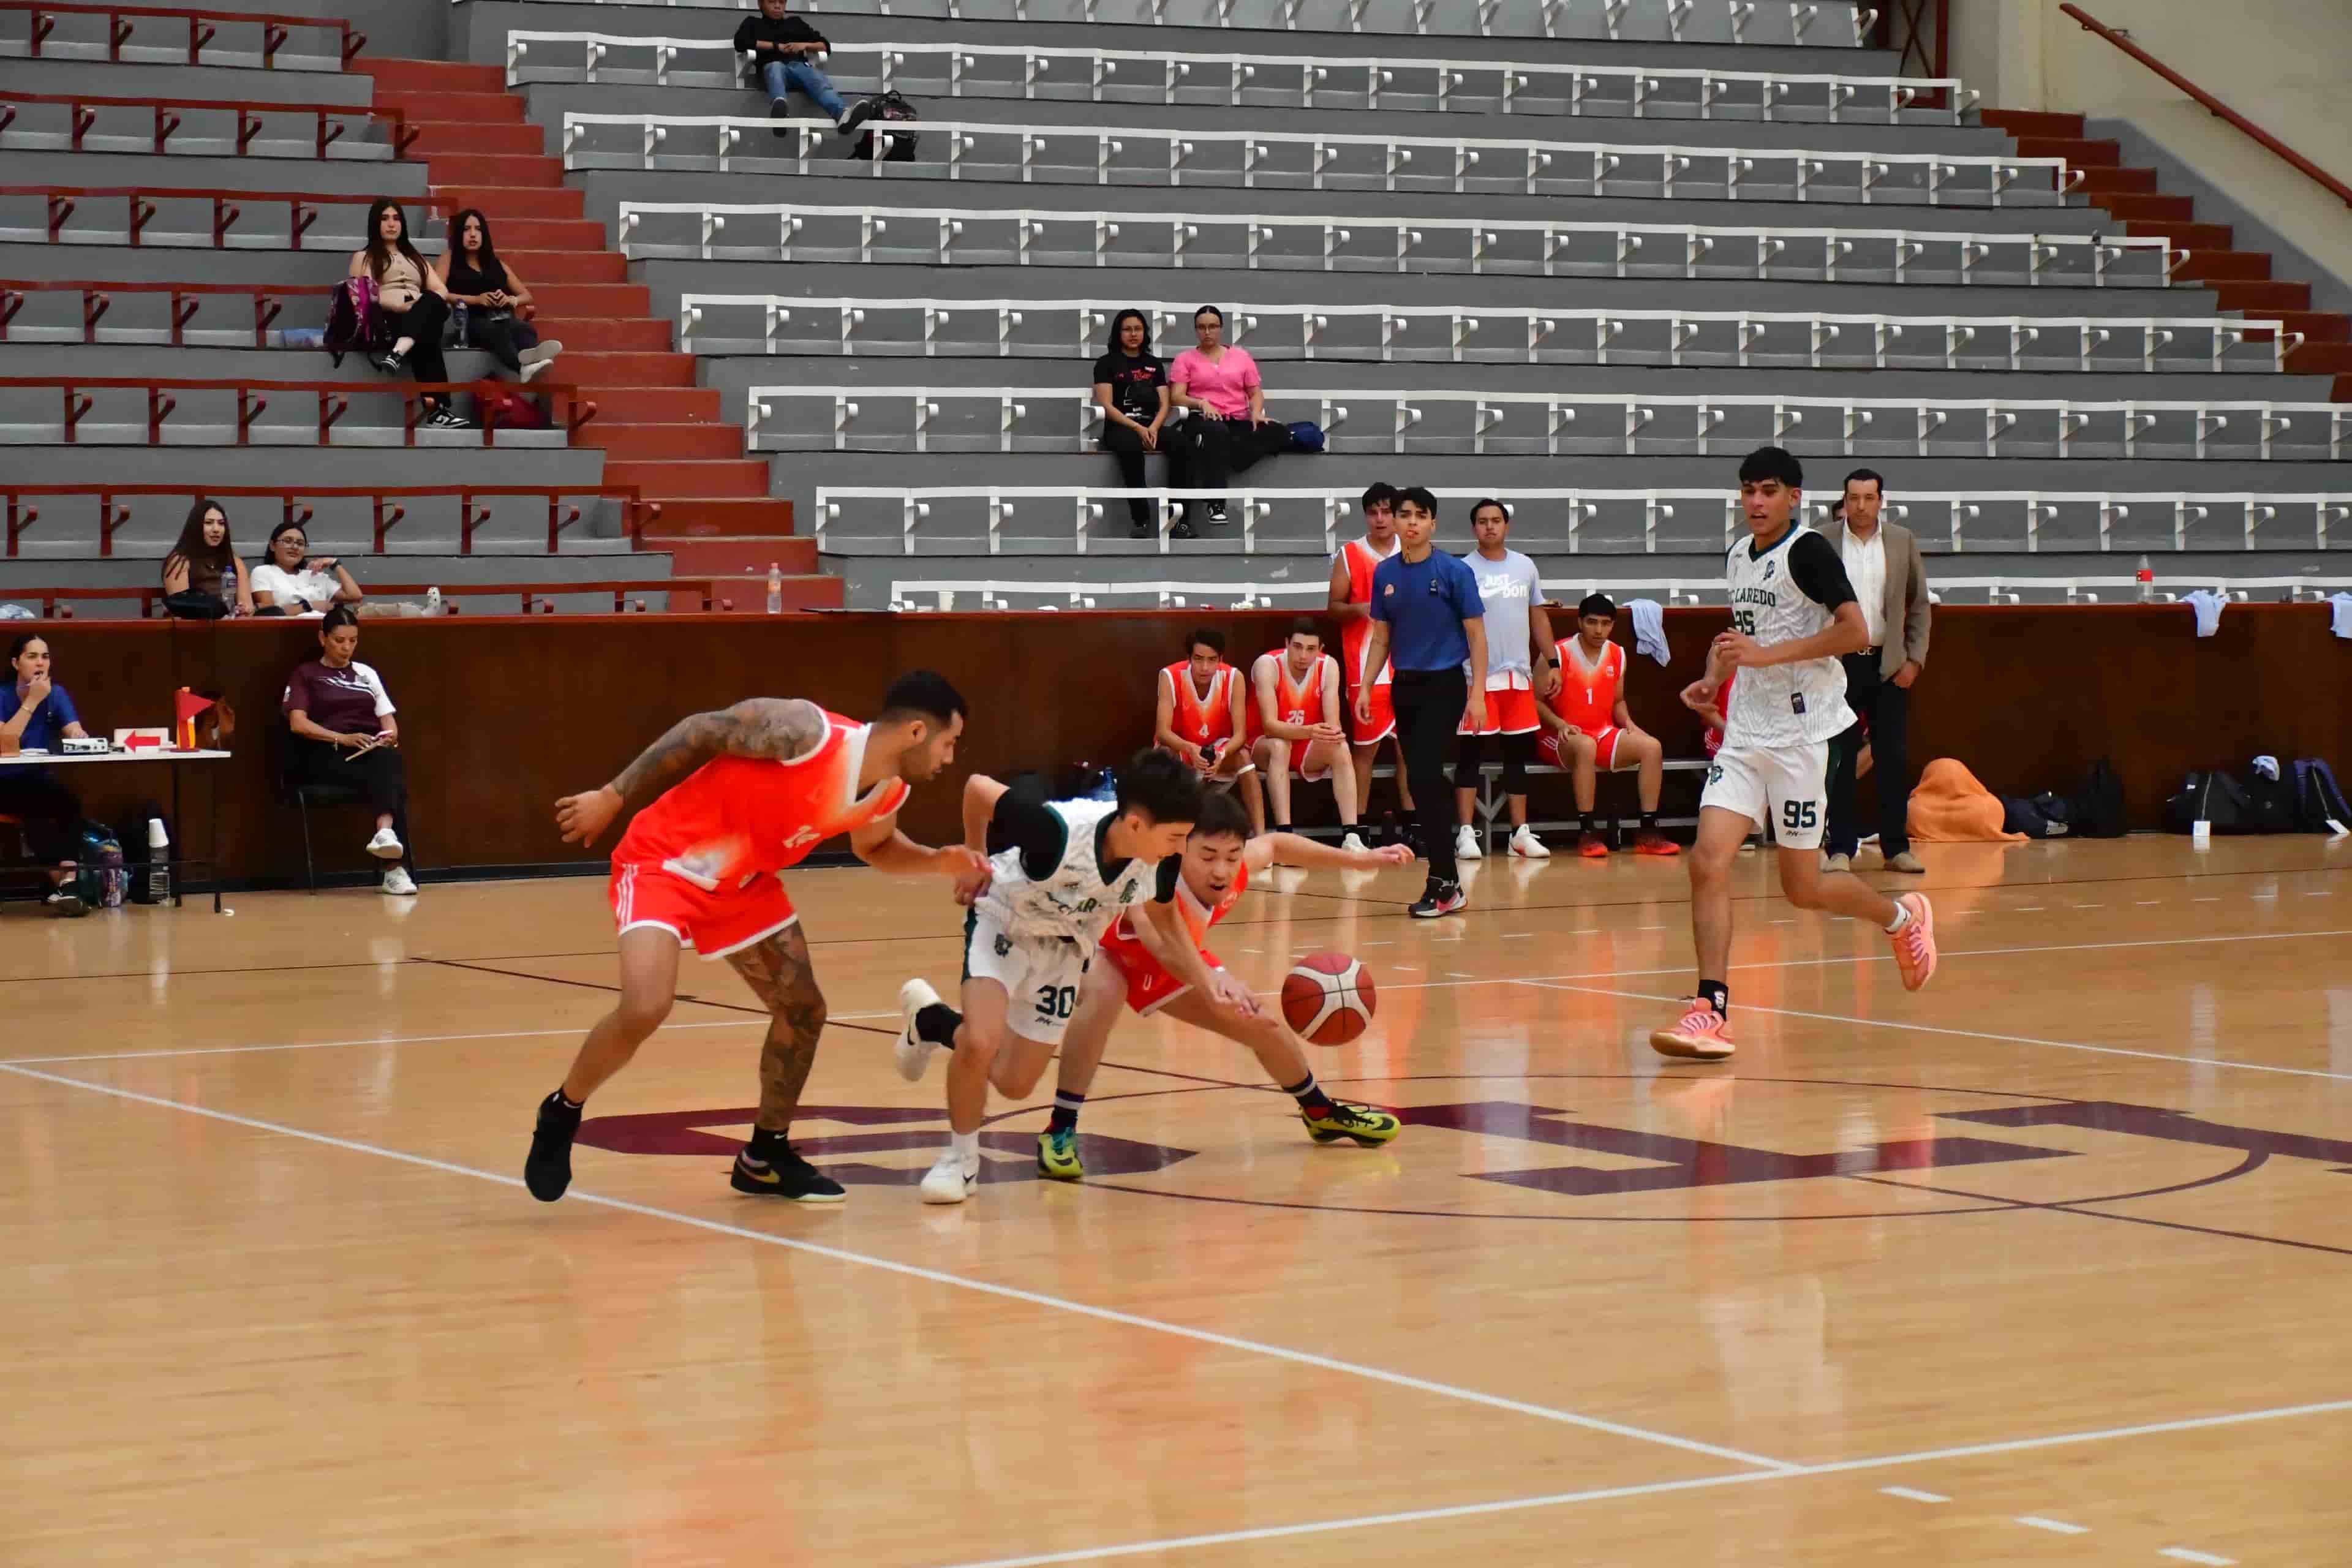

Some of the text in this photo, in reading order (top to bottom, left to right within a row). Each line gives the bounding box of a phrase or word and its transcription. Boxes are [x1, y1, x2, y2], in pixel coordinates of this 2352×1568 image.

[1735, 587, 1776, 607] LAREDO
[1586, 688, 1593, 704] 1
[1199, 723, 1209, 738] 4
[1783, 800, 1816, 828] 95
[1036, 985, 1075, 1019] 30
